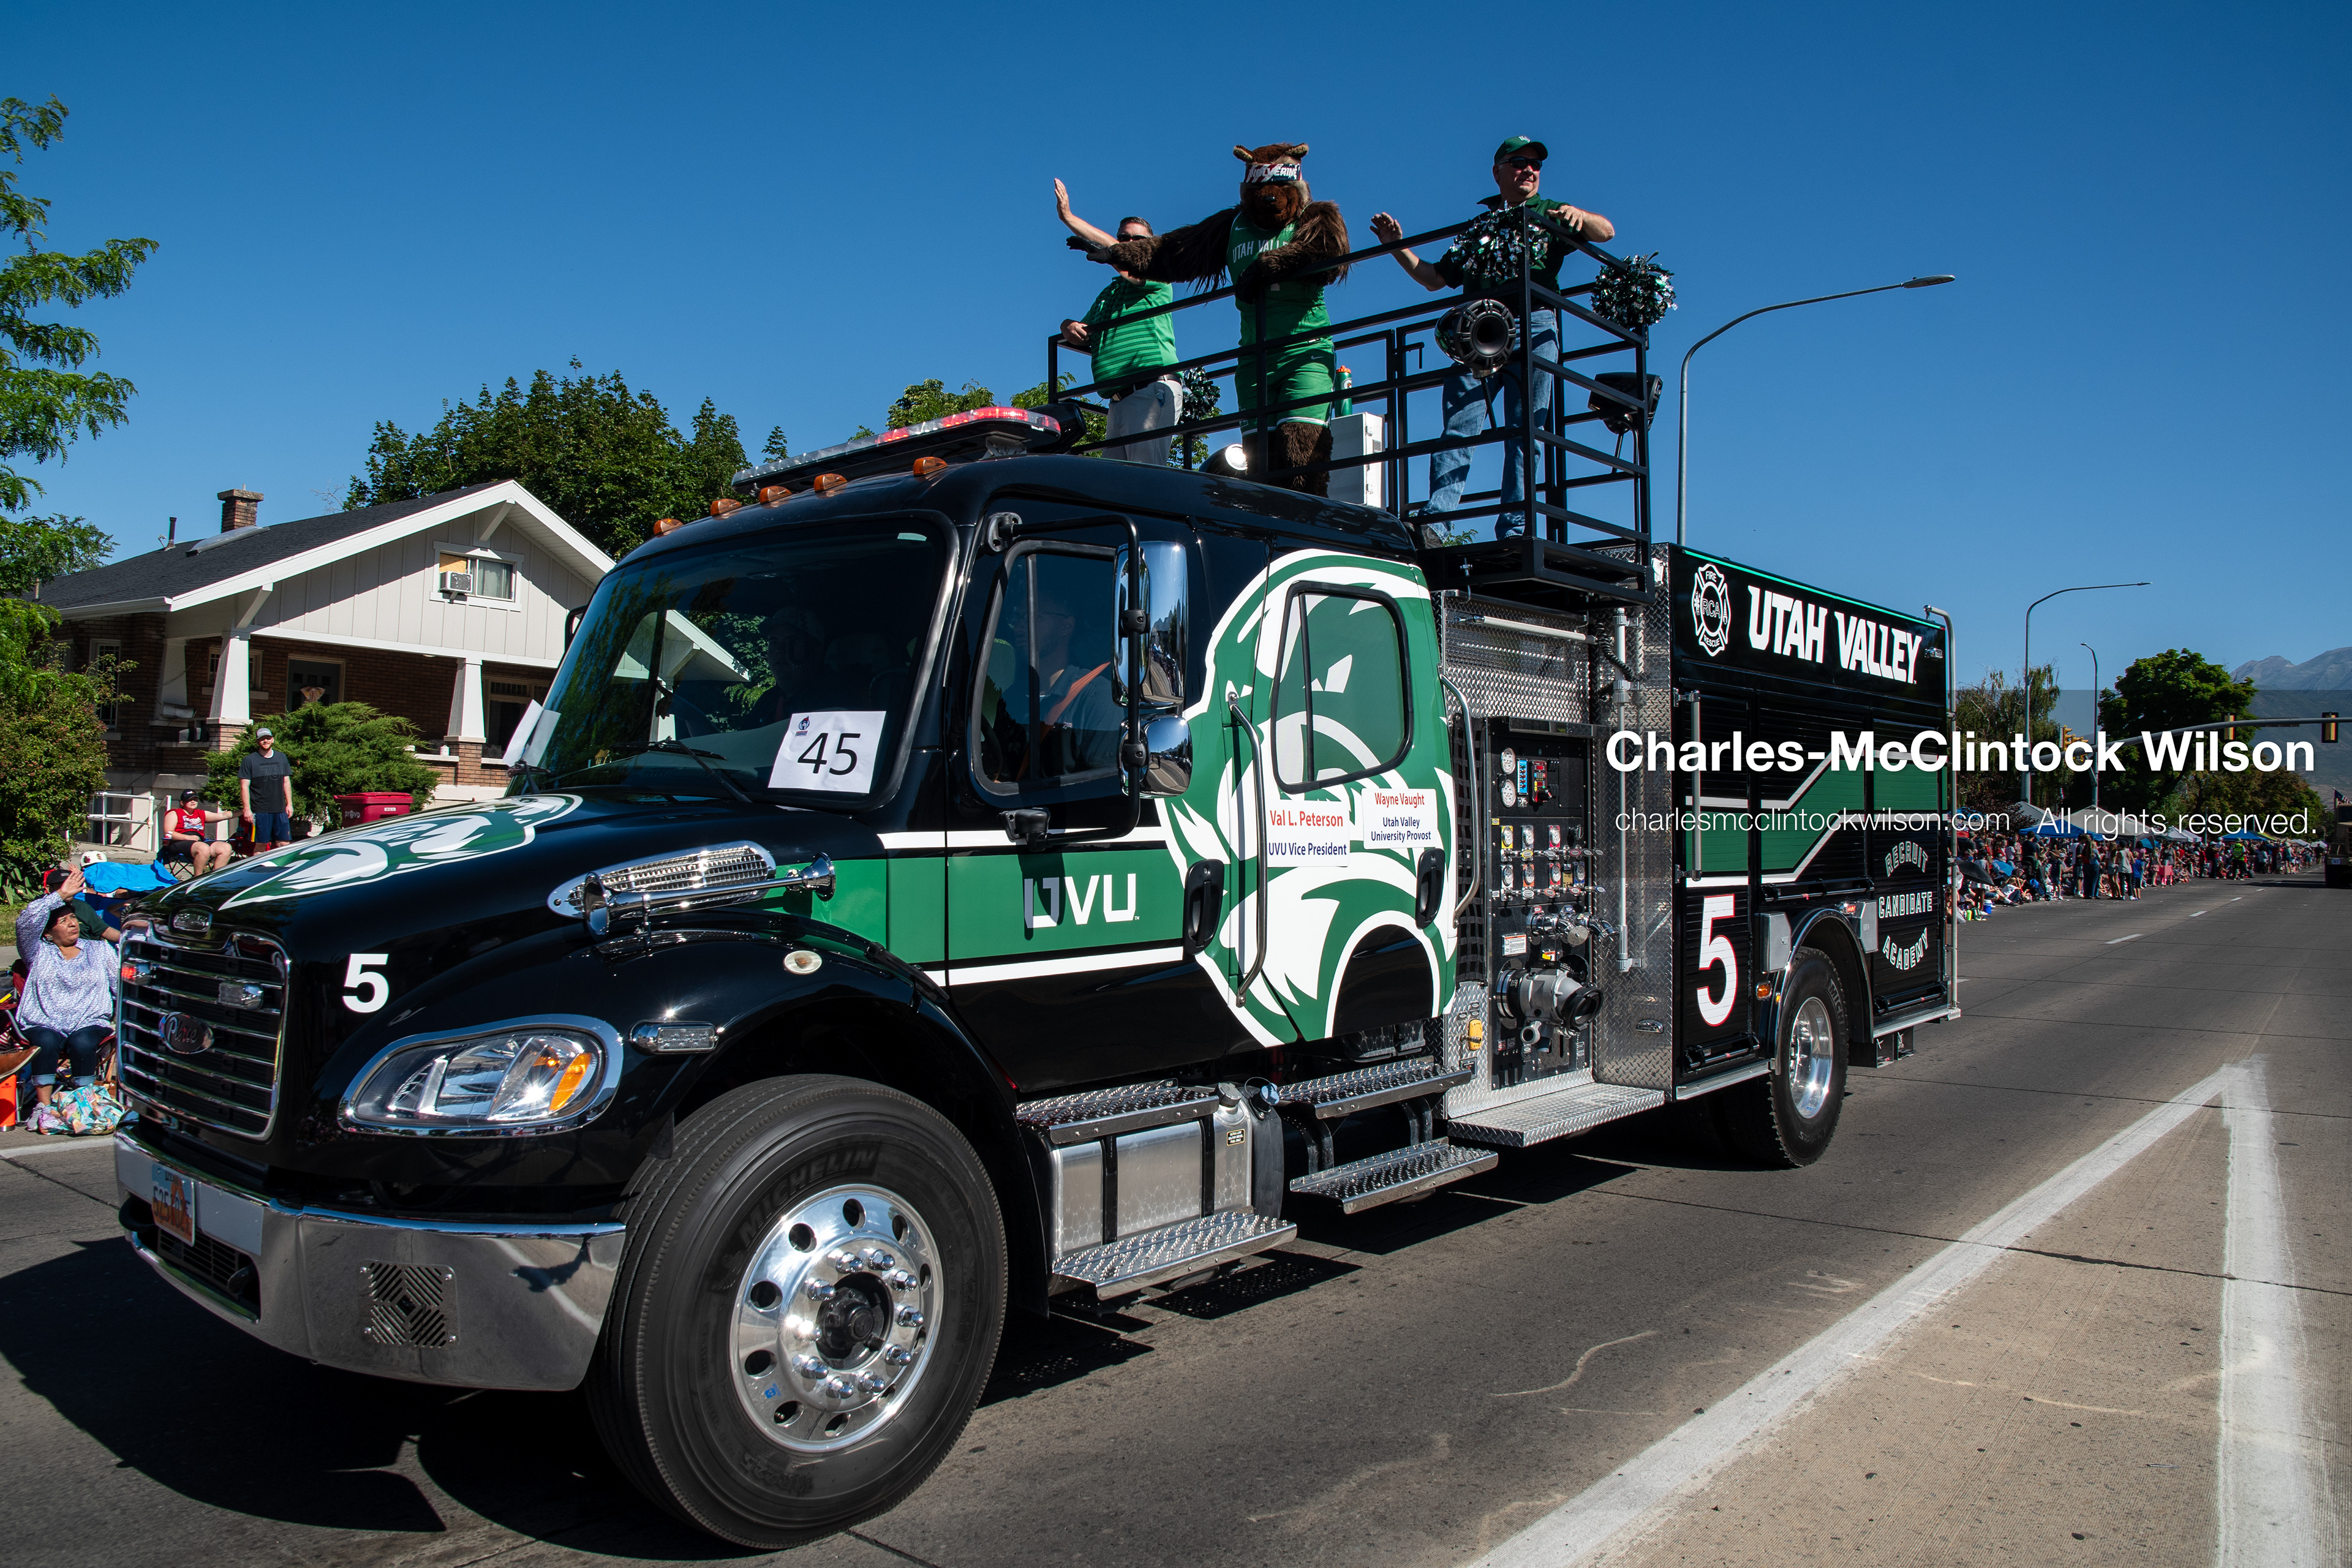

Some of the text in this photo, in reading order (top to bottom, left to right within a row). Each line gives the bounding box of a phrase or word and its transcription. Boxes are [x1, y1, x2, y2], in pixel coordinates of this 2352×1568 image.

[1233, 239, 1289, 263] UTAH VALL
[1705, 571, 1717, 582] FIRE
[1702, 598, 1721, 619] RCA
[1703, 634, 1721, 647] RESCUE
[1747, 585, 1922, 684] UTAH VALLEY
[797, 732, 861, 775] 45
[1374, 793, 1425, 809] Wayne Vaught
[1270, 810, 1343, 827] Val L. Peterson
[1382, 816, 1420, 829] Utah Valley
[1268, 842, 1347, 856] UVU Vice President
[1371, 830, 1431, 843] University Provost
[1885, 840, 1928, 877] RECRUIT
[1024, 873, 1136, 929] UVU
[1878, 891, 1932, 919] CANDIDATE
[1696, 894, 1738, 1027] 5
[1882, 927, 1929, 970] ACADEMY
[342, 953, 390, 1014] 5
[739, 1148, 878, 1247] MICHELIN
